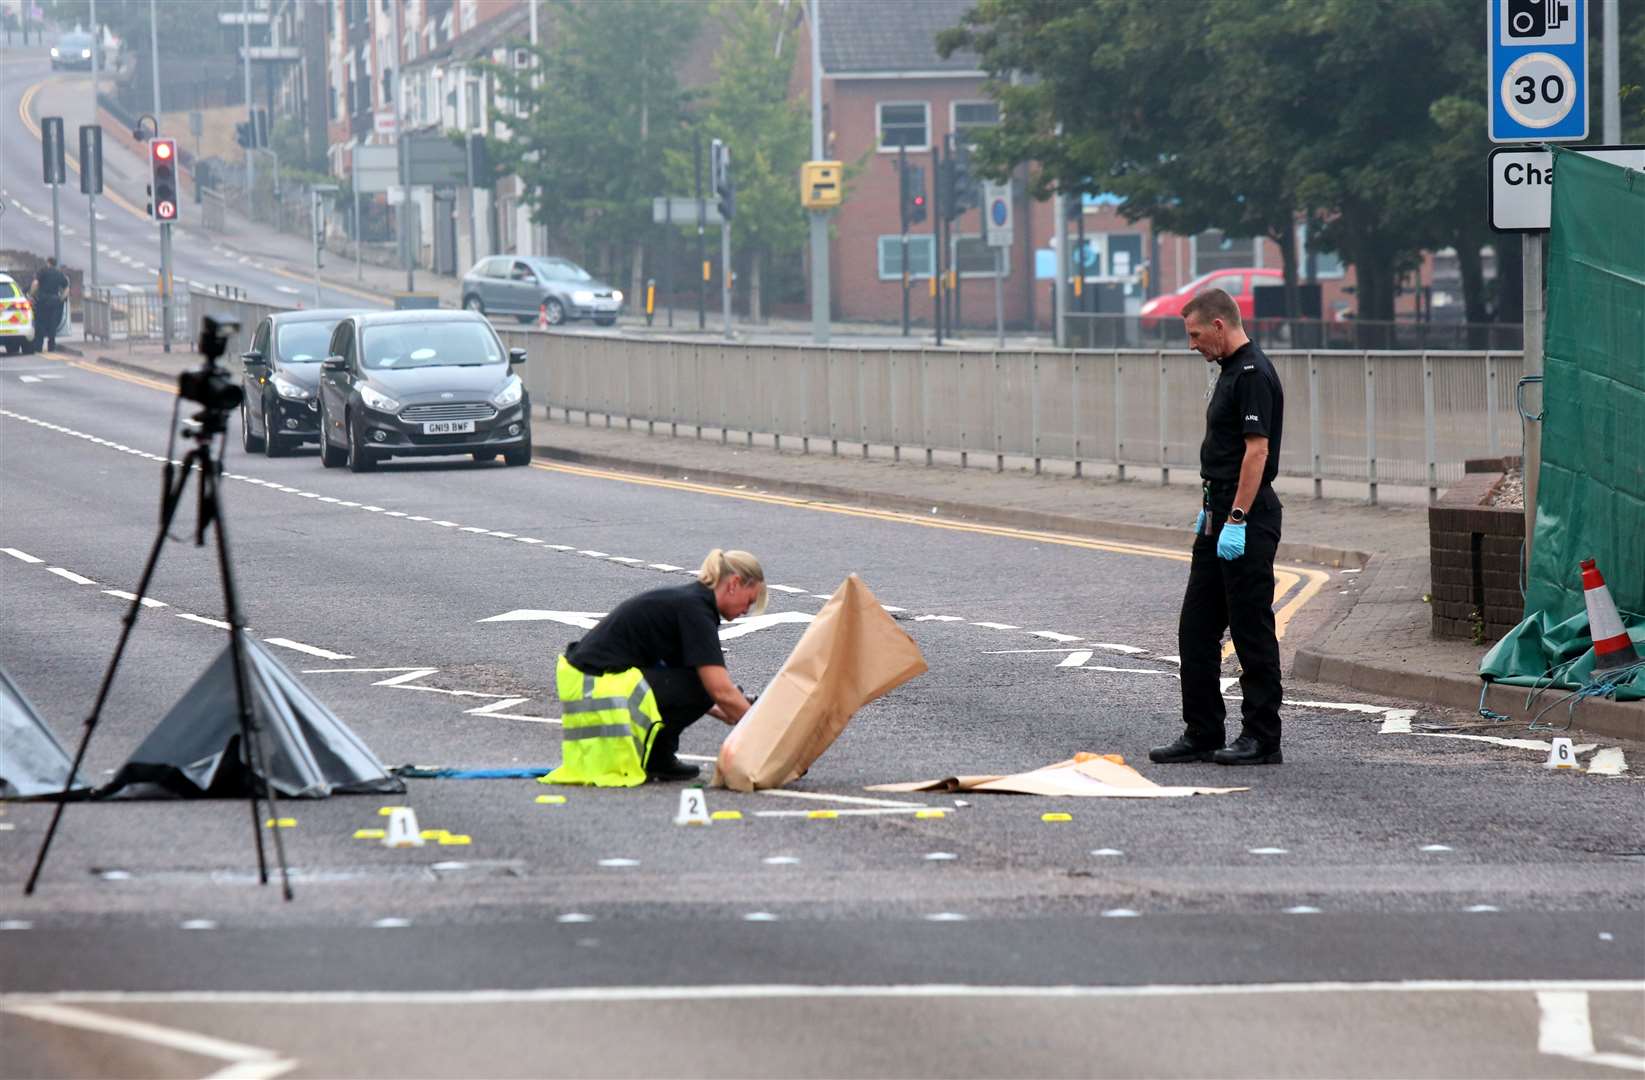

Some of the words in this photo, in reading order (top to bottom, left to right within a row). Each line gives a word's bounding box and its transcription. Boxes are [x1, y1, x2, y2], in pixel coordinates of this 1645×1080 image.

[1514, 74, 1565, 105] 30
[429, 422, 450, 432] GN19
[1558, 744, 1569, 760] 6
[688, 796, 699, 815] 2
[399, 817, 408, 835] 1
